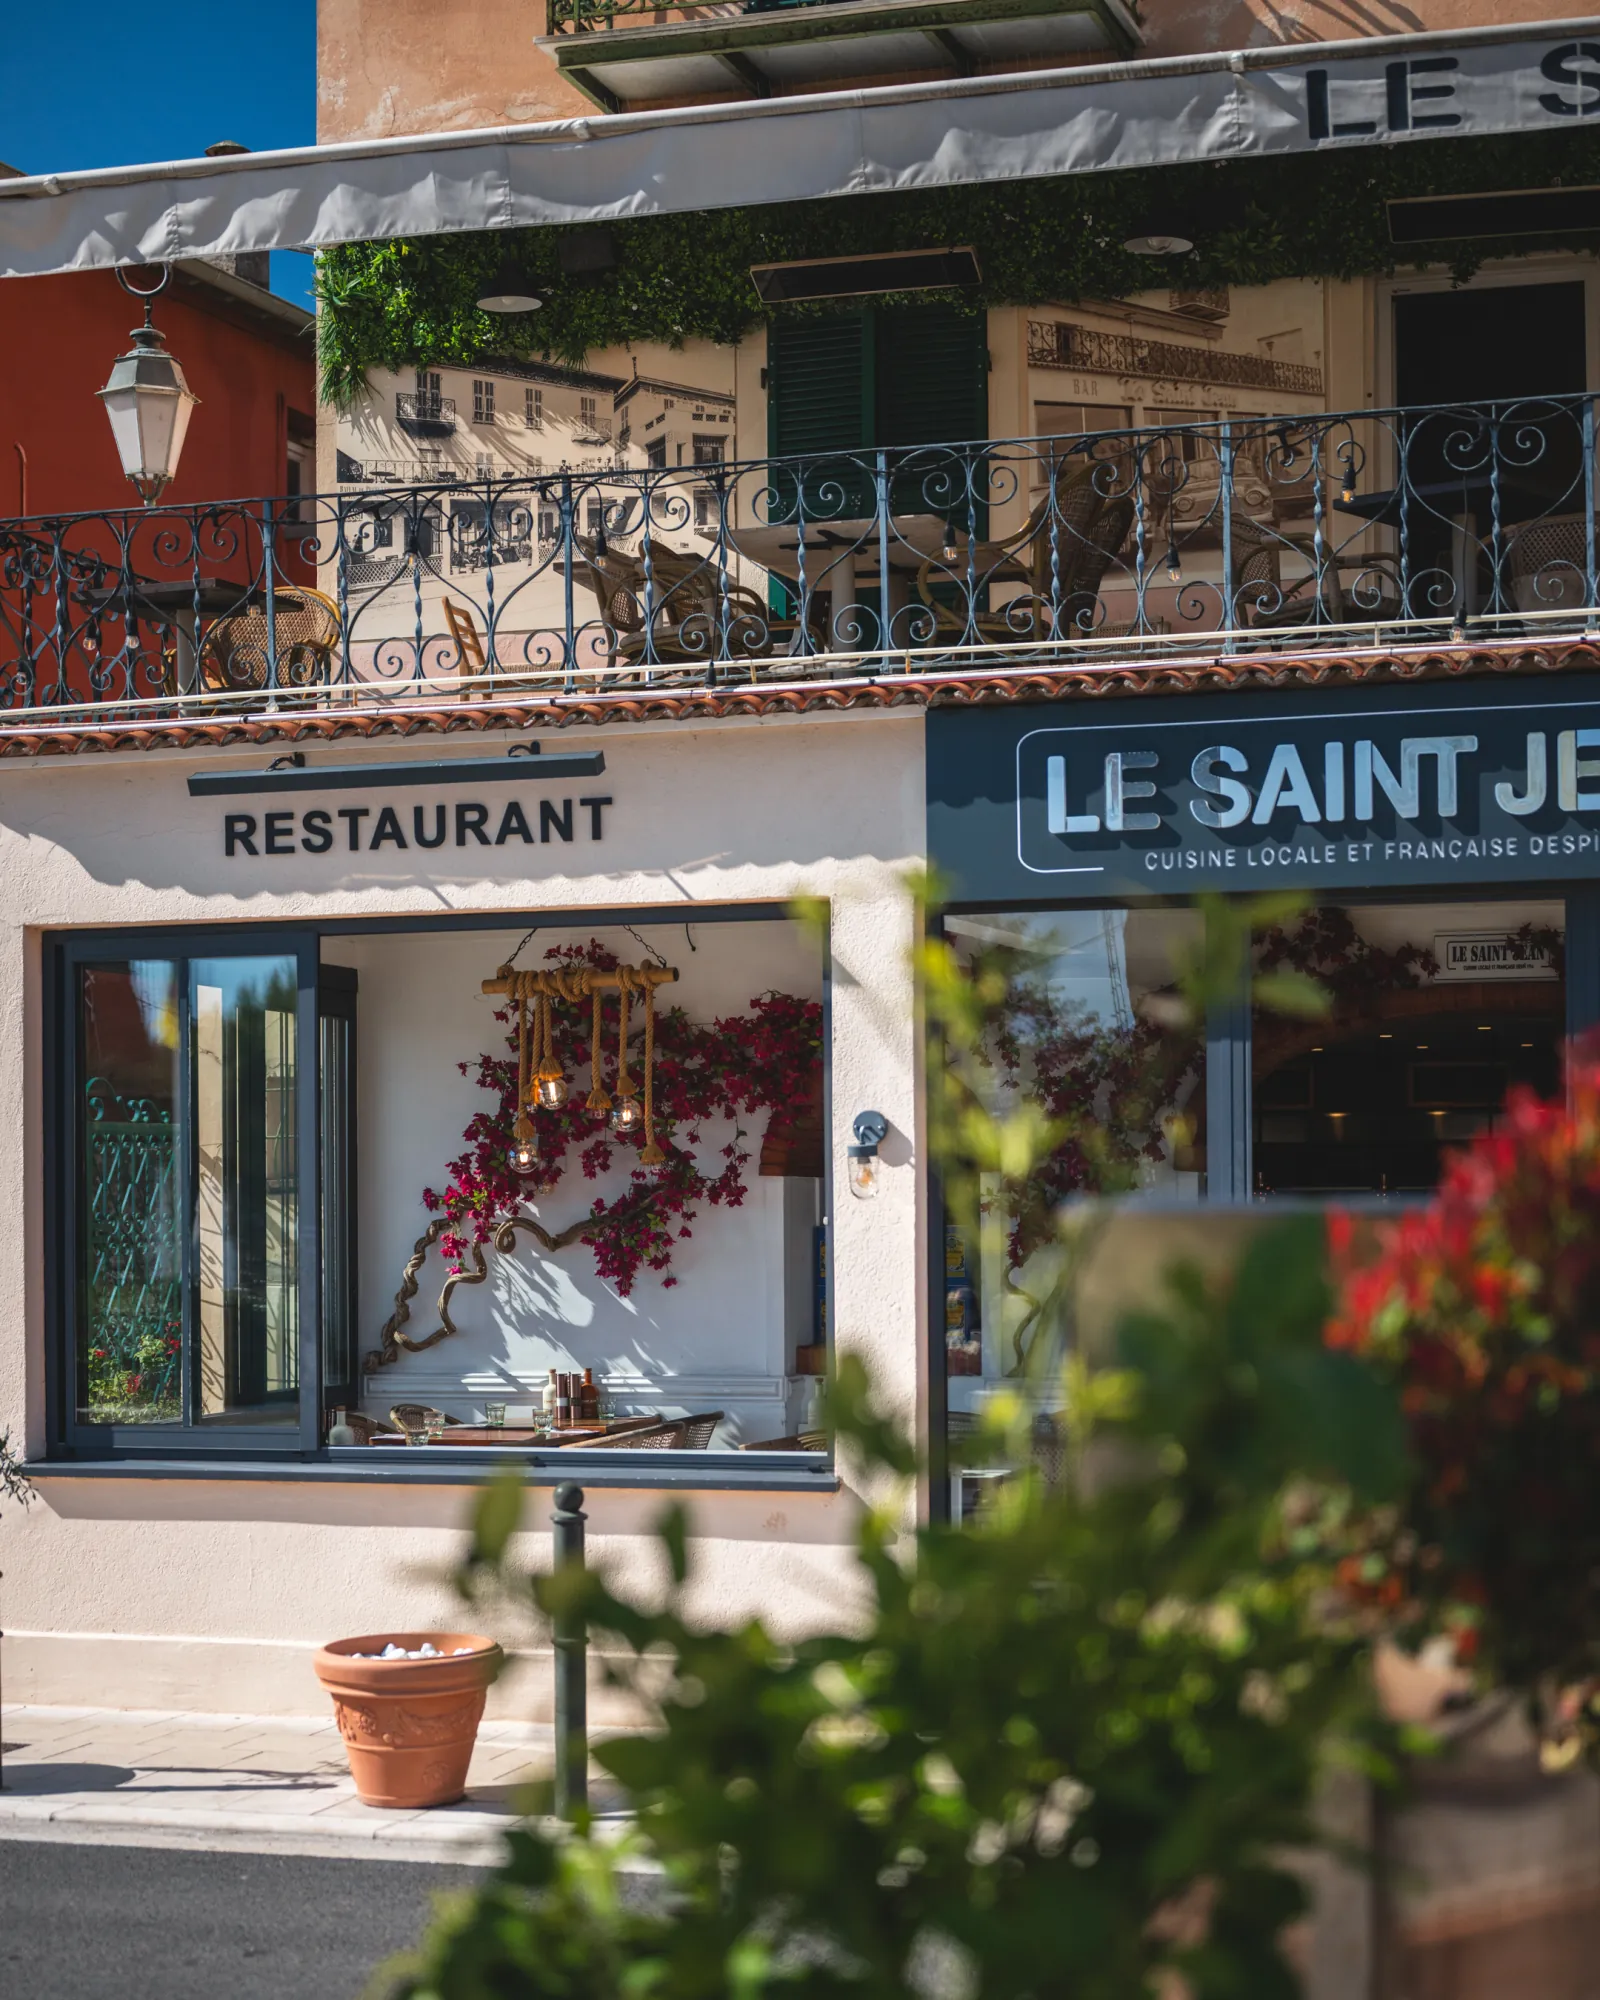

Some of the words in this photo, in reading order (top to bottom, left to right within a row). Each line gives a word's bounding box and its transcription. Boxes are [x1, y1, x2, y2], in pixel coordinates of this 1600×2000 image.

[1306, 57, 1461, 140] LE
[1538, 43, 1600, 116] S
[1073, 378, 1098, 396] BAR
[1047, 751, 1159, 834] LE
[1190, 735, 1478, 828] SAINT
[1495, 728, 1600, 816] JE
[224, 796, 613, 857] RESTAURANT
[1144, 849, 1237, 871] CUISINE
[1247, 844, 1337, 867] LOCALE
[1347, 843, 1374, 863] ET
[1385, 837, 1518, 862] FRANÇAISE
[1451, 945, 1468, 963] LE
[1470, 943, 1507, 962] SAINT
